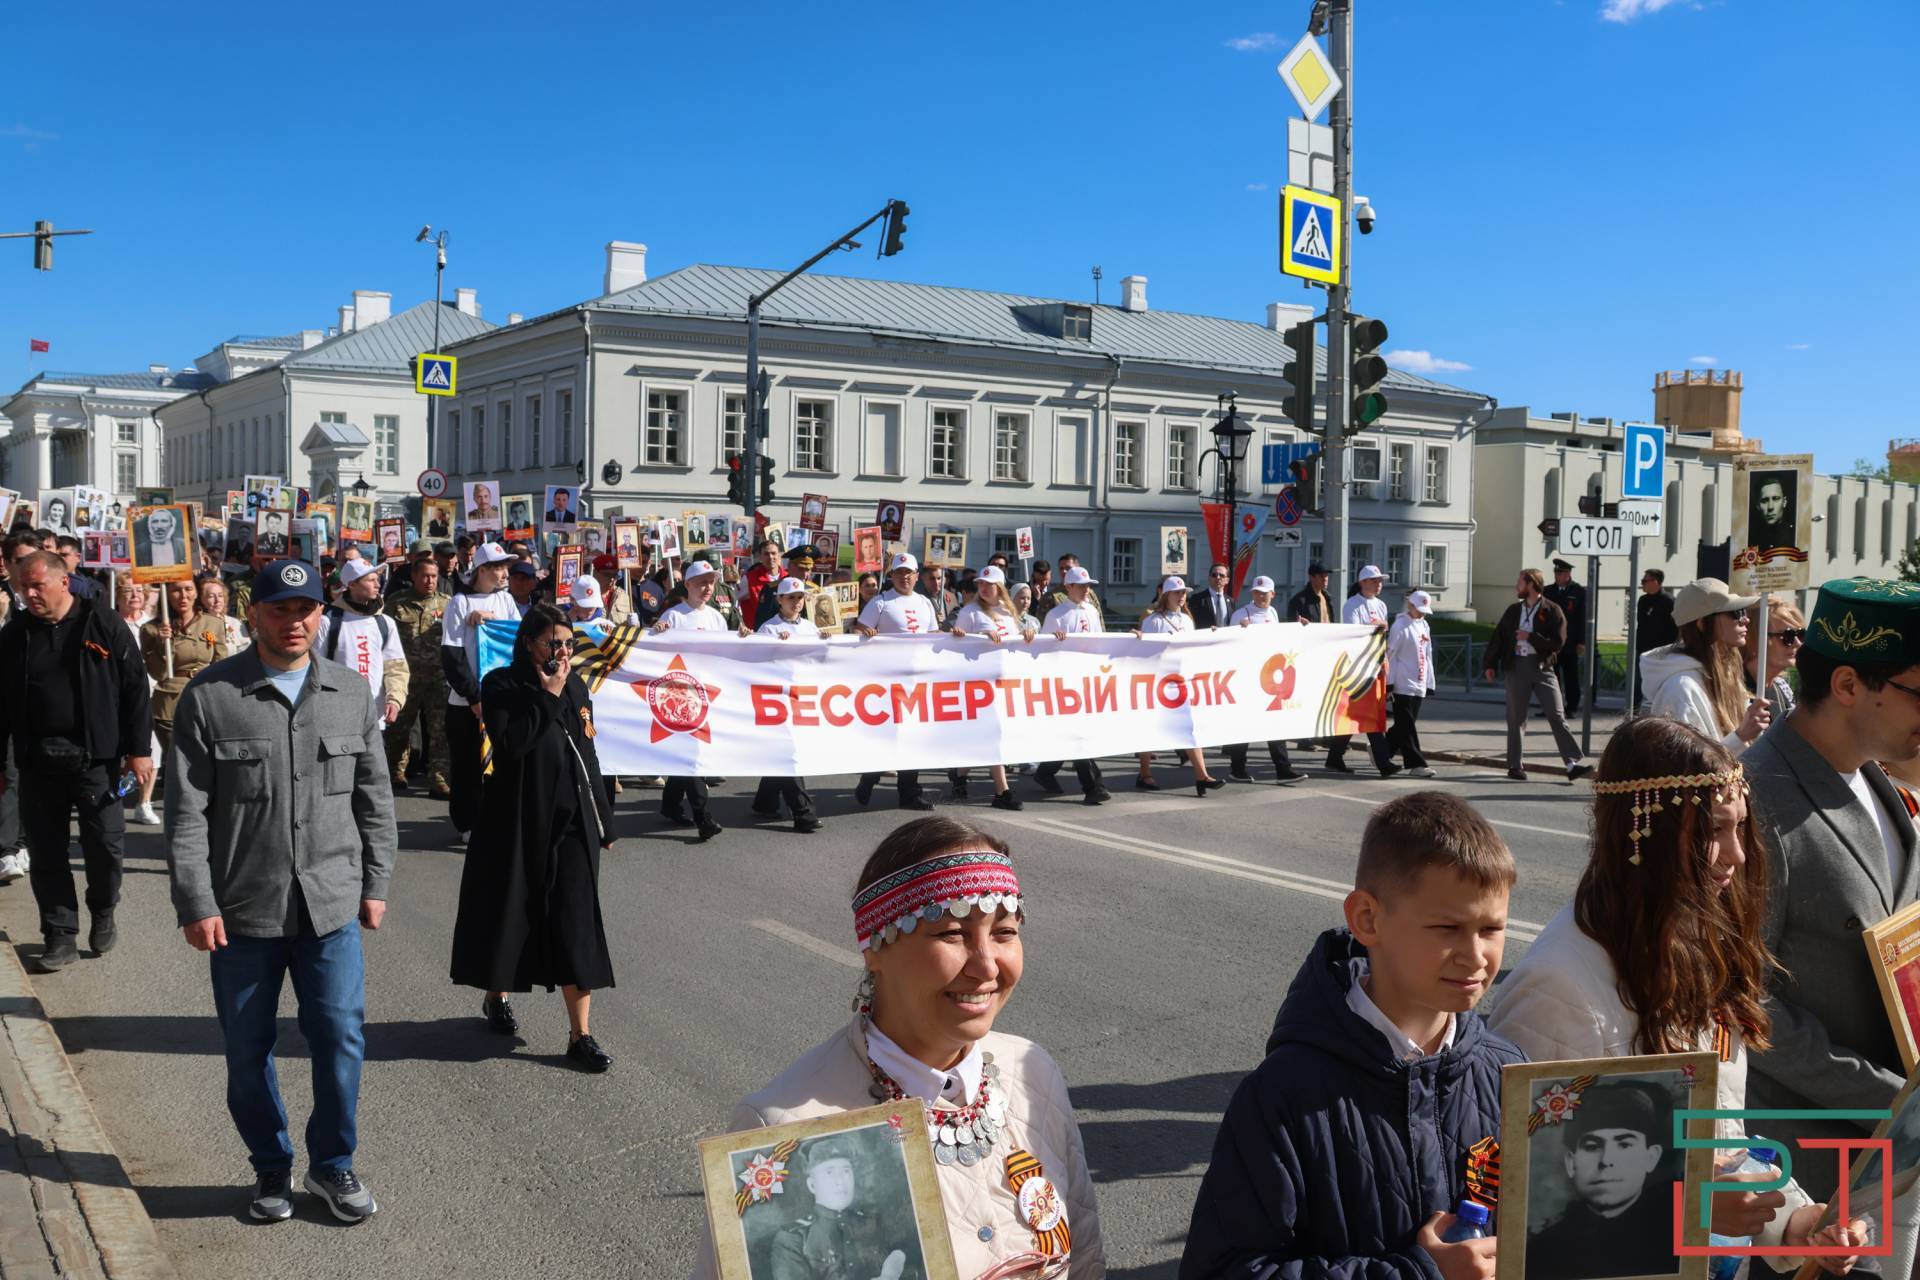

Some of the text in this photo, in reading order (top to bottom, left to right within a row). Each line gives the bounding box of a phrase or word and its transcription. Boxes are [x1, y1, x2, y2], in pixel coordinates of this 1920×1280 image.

[424, 478, 441, 490] 40
[1634, 433, 1658, 489] P
[1570, 525, 1622, 549] СТОП
[356, 635, 371, 679] ЕДА!
[1259, 652, 1297, 711] 9
[750, 664, 1118, 727] БЕССМЕРТНЫЙ
[1129, 669, 1237, 710] ПОЛК
